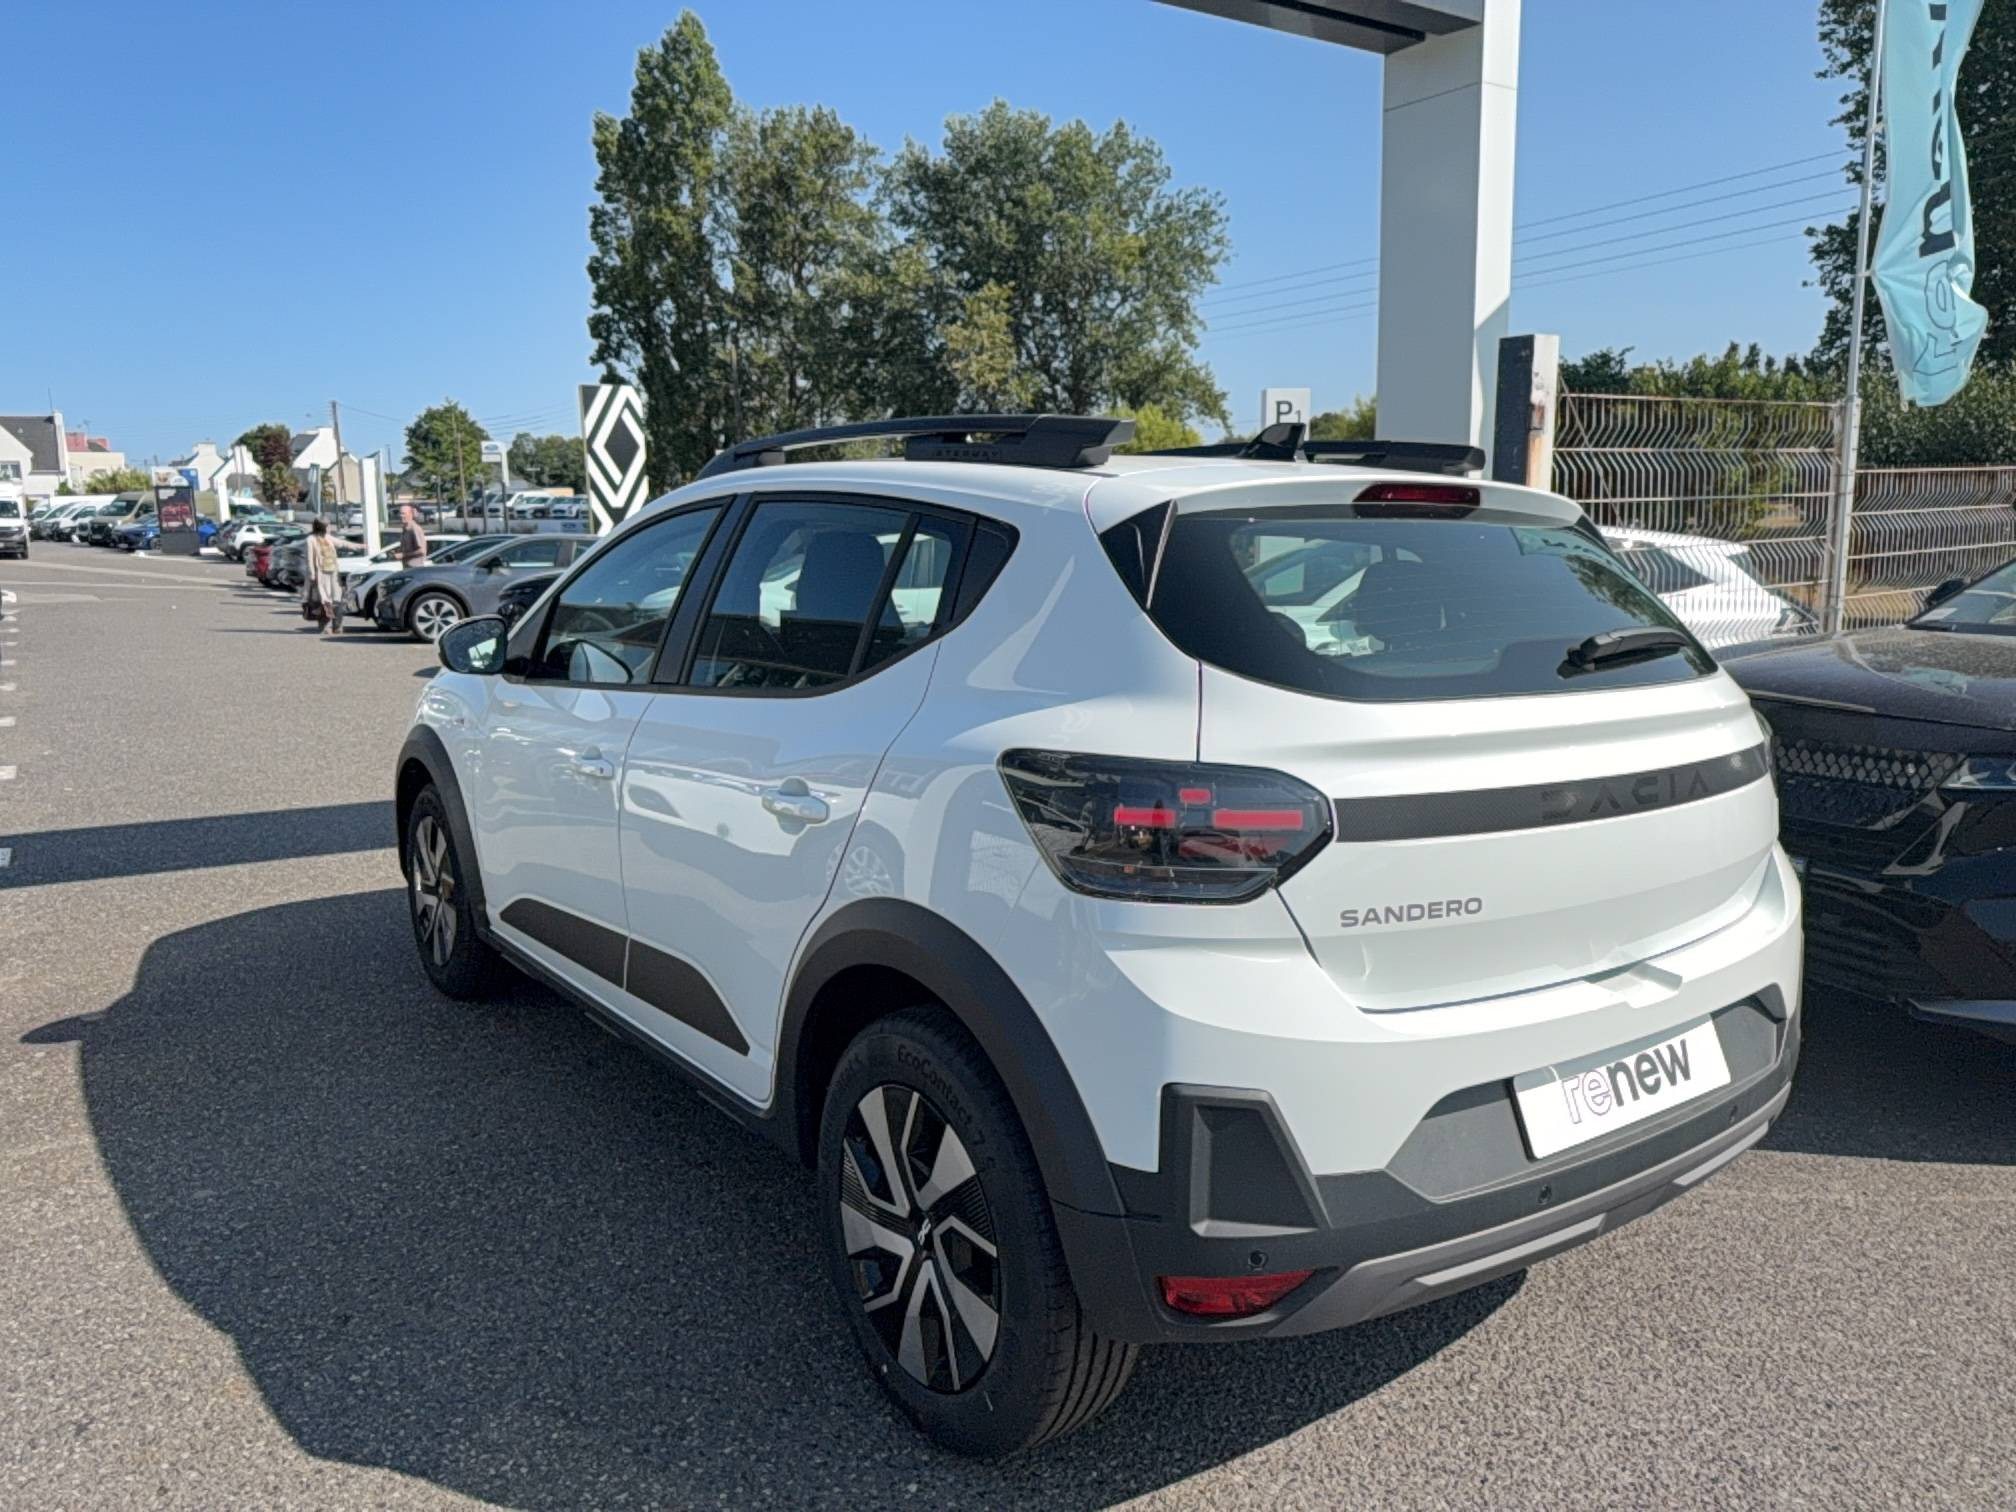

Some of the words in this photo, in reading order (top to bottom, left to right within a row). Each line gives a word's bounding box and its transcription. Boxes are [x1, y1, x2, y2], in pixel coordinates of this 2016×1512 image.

[1541, 769, 1709, 820] DACIA
[1339, 896, 1483, 928] SANDERO
[1560, 1038, 1692, 1125] renew
